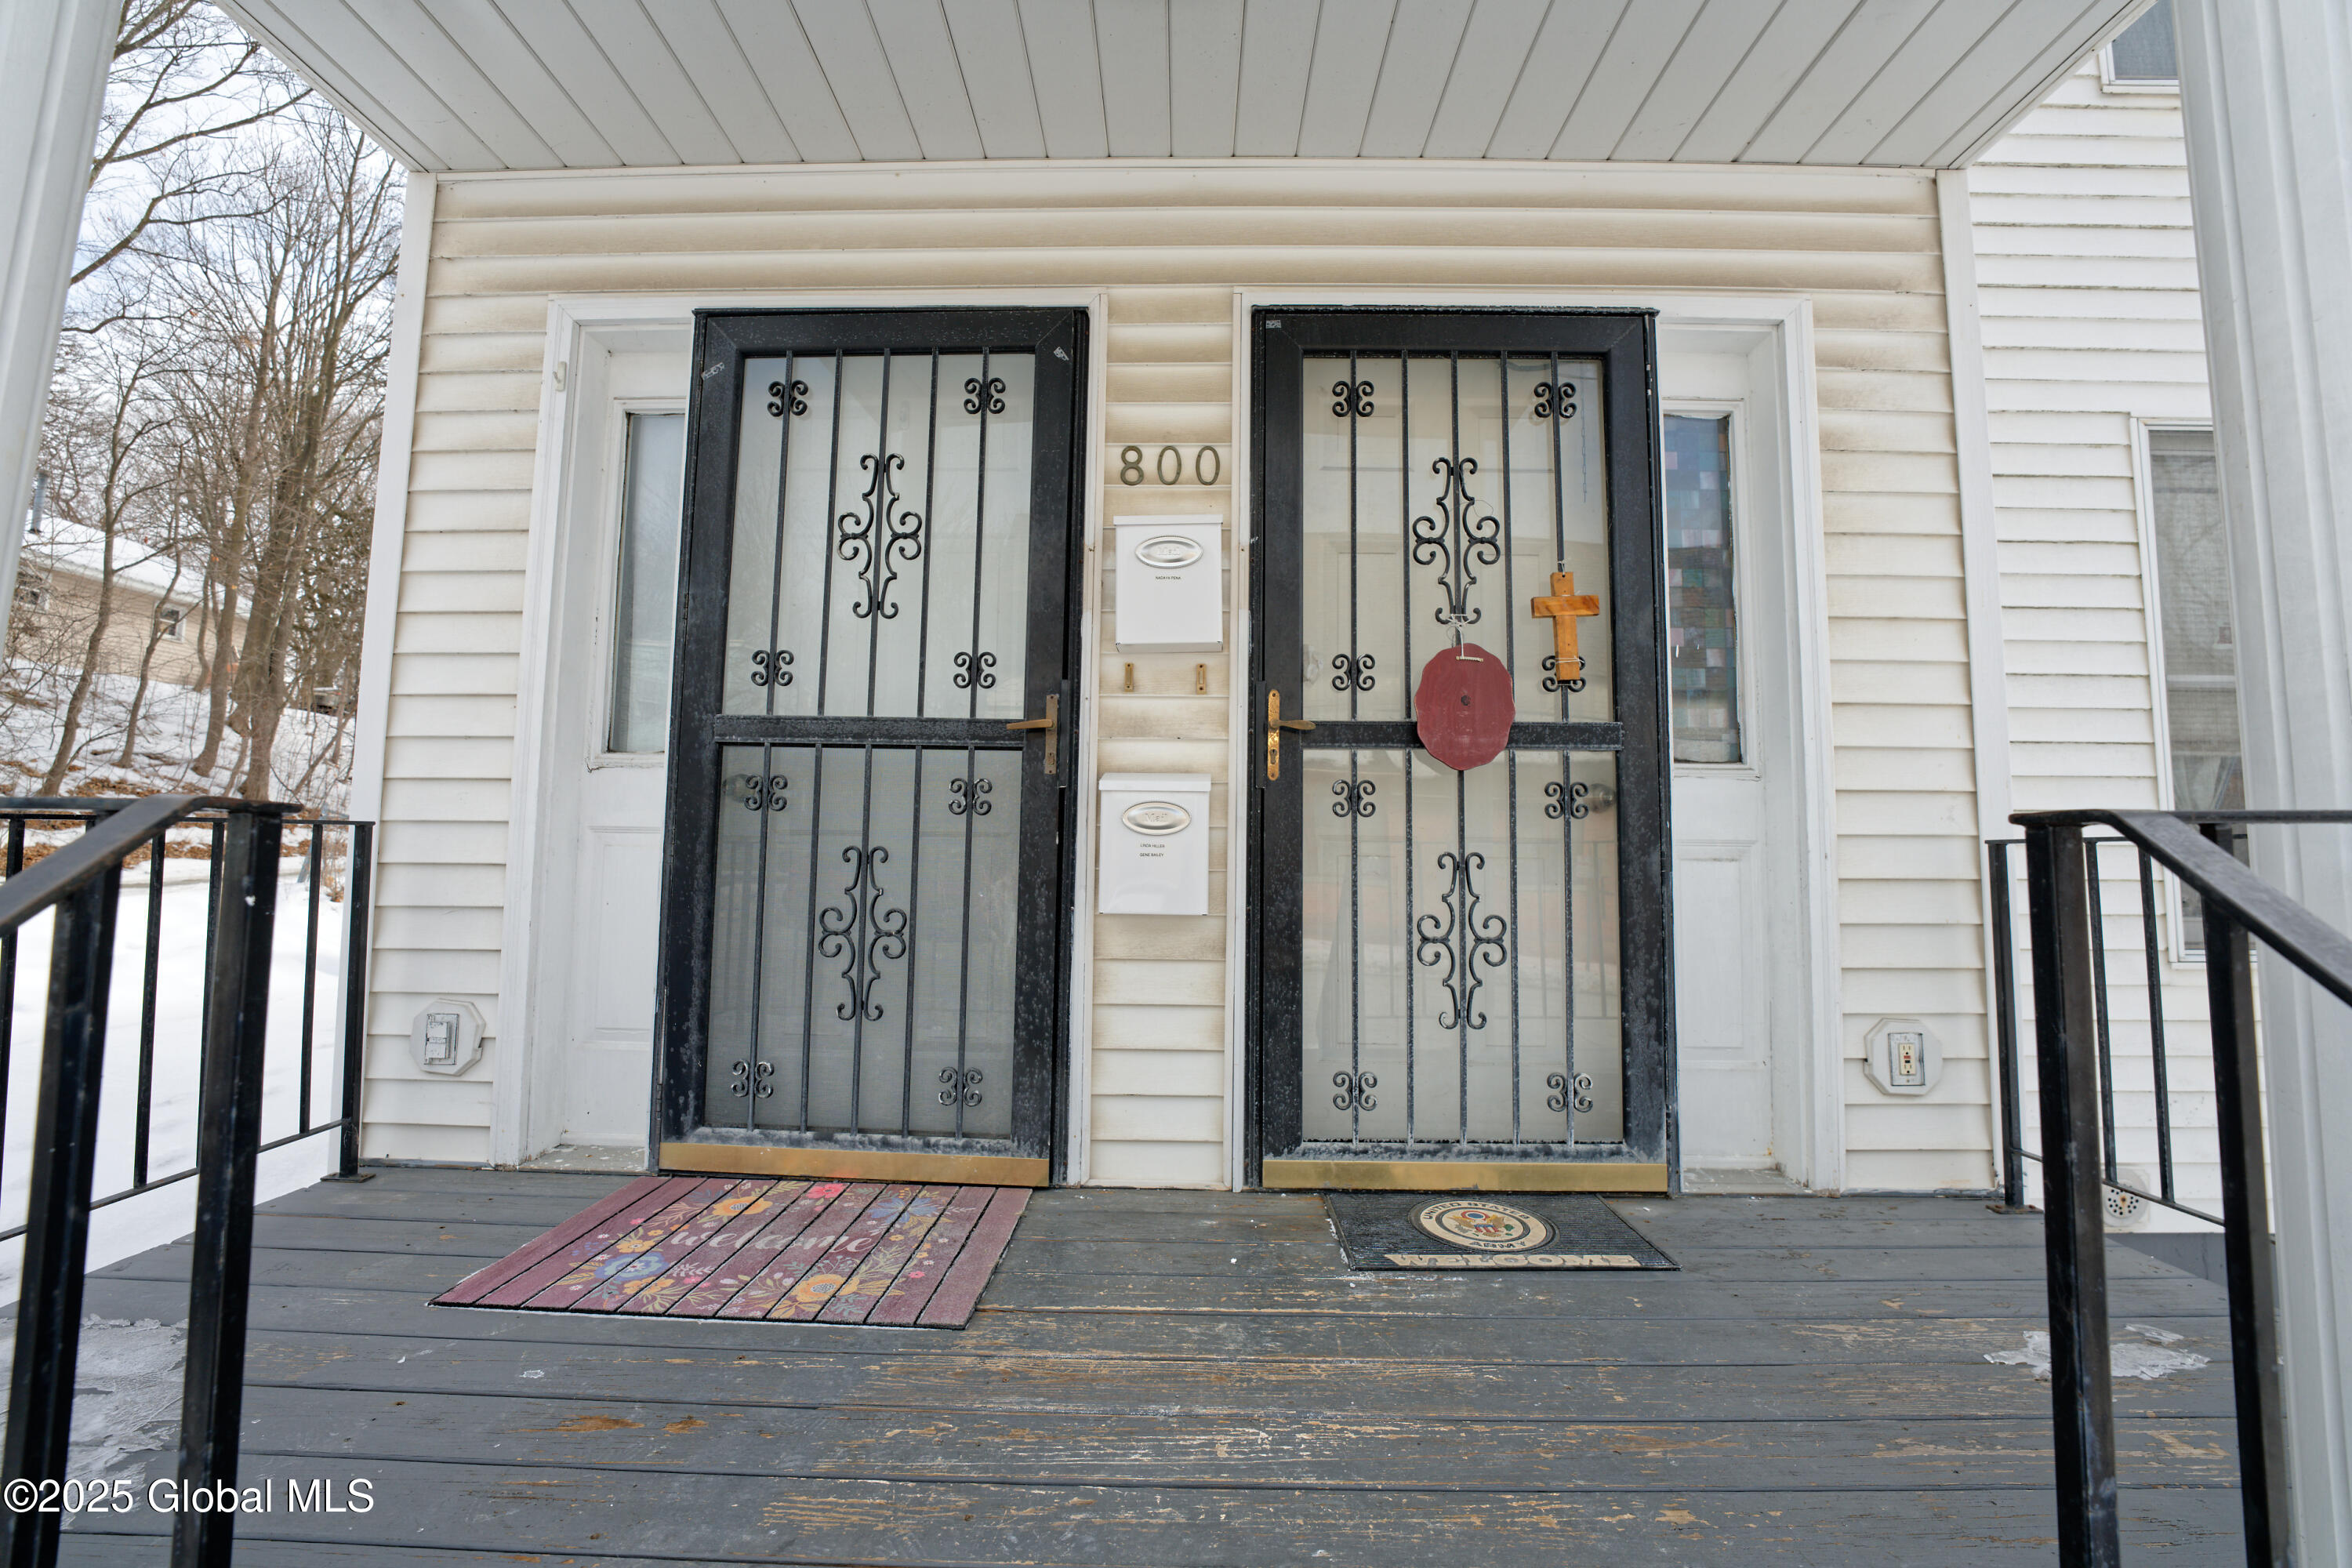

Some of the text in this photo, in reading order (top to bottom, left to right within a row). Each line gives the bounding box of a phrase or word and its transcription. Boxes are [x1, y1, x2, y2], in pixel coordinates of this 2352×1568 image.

[1120, 445, 1220, 485] 800
[1423, 1202, 1530, 1220] UNITED STATES
[670, 1224, 877, 1253] welcome
[1468, 1240, 1527, 1249] ARMY
[1385, 1254, 1642, 1266] WELCOME
